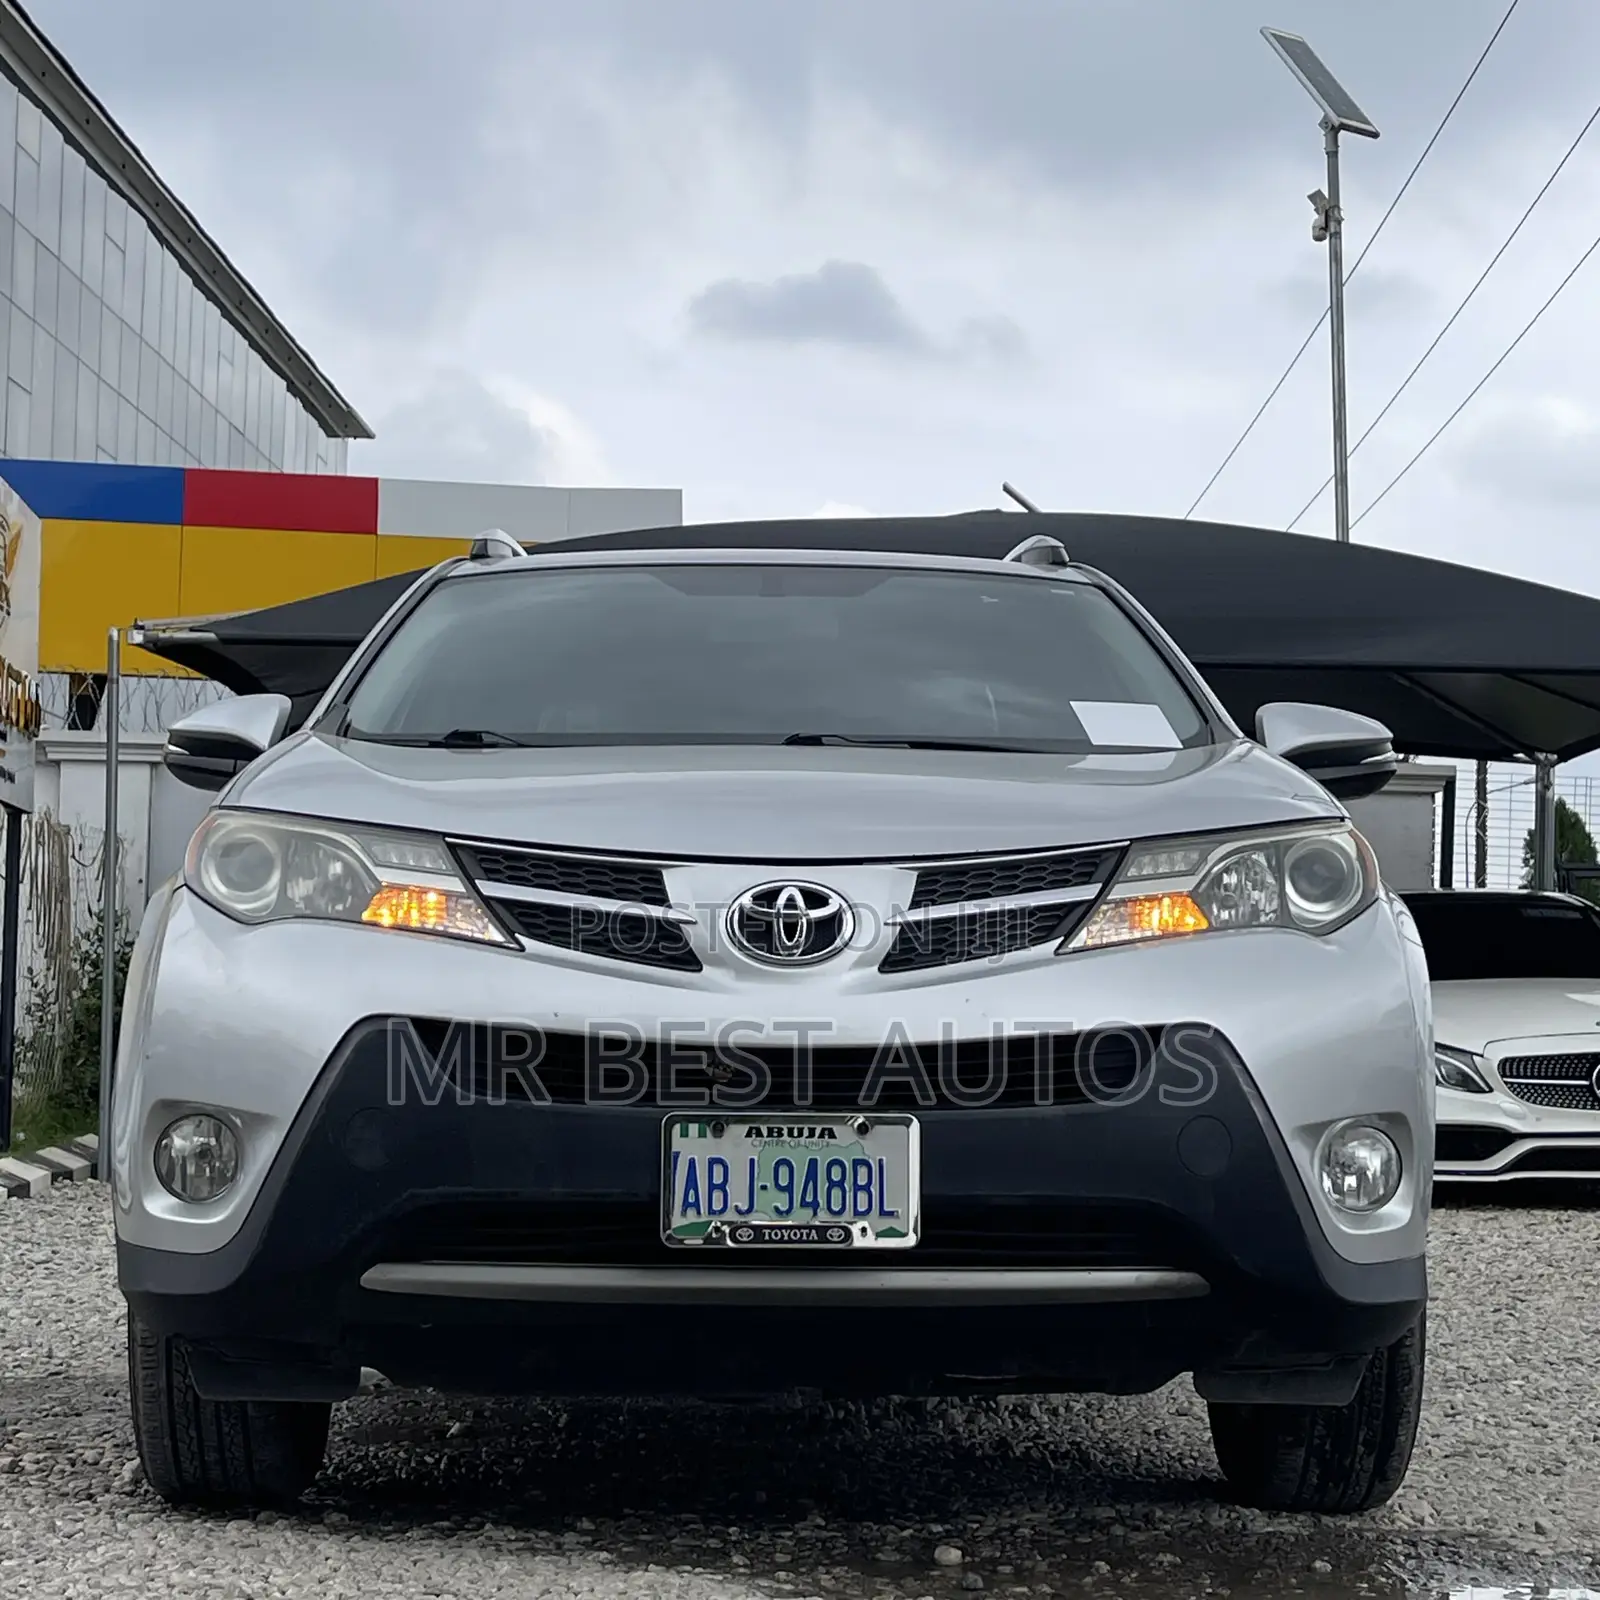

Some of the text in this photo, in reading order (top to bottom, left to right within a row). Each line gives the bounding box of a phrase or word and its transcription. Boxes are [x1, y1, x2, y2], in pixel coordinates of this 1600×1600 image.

[744, 1125, 838, 1140] ABUJA
[680, 1156, 900, 1217] ABJ-948BL
[762, 1229, 819, 1241] TOYOTA
